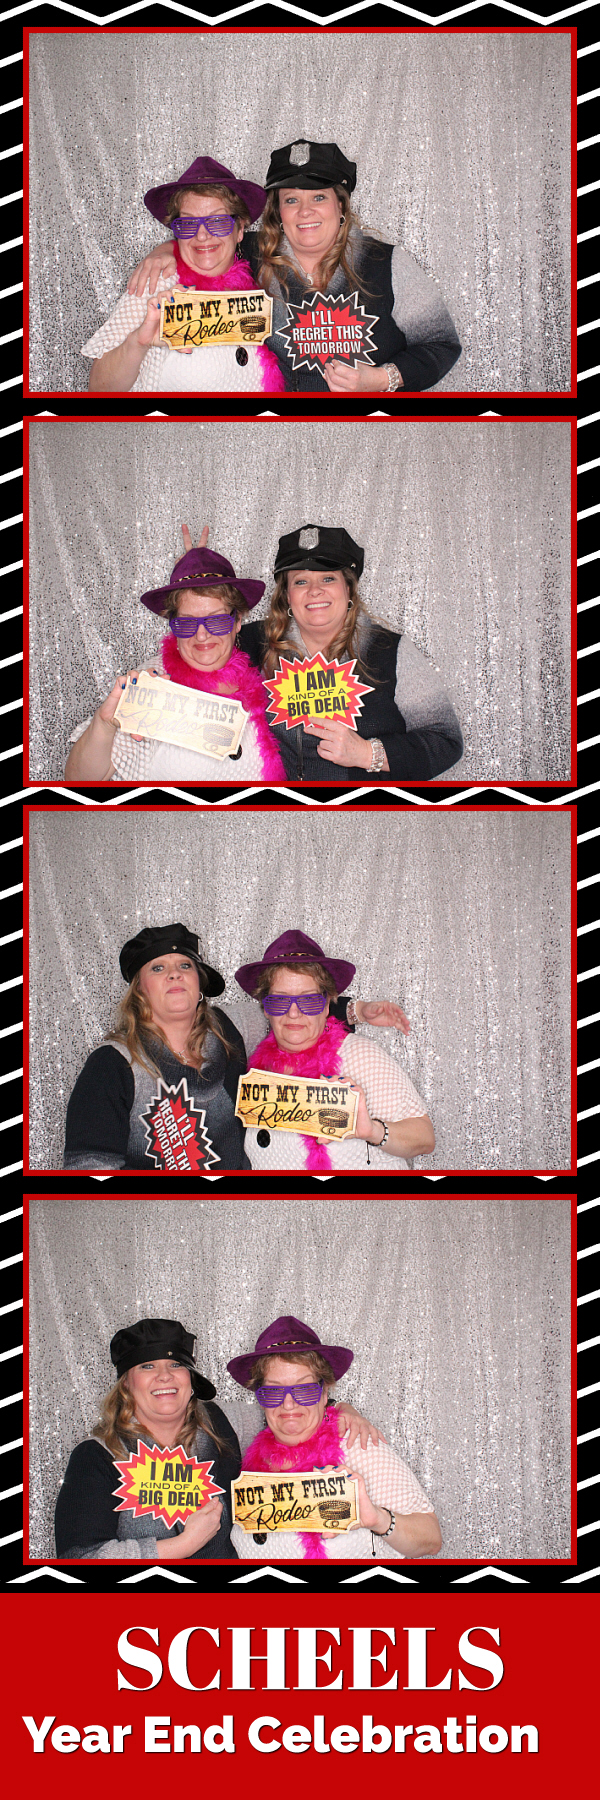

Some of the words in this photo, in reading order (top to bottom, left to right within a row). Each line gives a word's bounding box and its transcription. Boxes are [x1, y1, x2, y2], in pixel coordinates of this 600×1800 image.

[165, 303, 193, 323] NOT
[200, 300, 221, 318] MY
[227, 295, 264, 315] FIRST
[312, 310, 335, 326] I'LL
[177, 315, 241, 346] Rodeo
[292, 326, 333, 341] REGRET
[337, 325, 363, 340] THIS
[298, 341, 361, 354] TOMORROW
[293, 674, 300, 692] I
[307, 669, 336, 690] AM
[125, 685, 157, 706] NOT
[161, 692, 187, 713] MY
[196, 699, 238, 724] FIRST
[287, 692, 316, 700] KIND
[287, 698, 310, 717] BIG
[315, 696, 350, 713] DEAL
[130, 709, 203, 737] Rodeo
[241, 1084, 269, 1101] NOT
[276, 1085, 299, 1102] MY
[306, 1086, 349, 1105] FIRST
[158, 1098, 183, 1149] REGRET
[250, 1102, 316, 1129] Rodeo
[177, 1113, 195, 1146] I'LL
[150, 1462, 156, 1480] I
[163, 1463, 193, 1482] AM
[138, 1490, 164, 1506] BIG
[168, 1491, 202, 1507] DEAL
[235, 1487, 264, 1506] NOT
[271, 1483, 295, 1502] MY
[303, 1476, 346, 1498] FIRST
[249, 1500, 317, 1531] Rodeo
